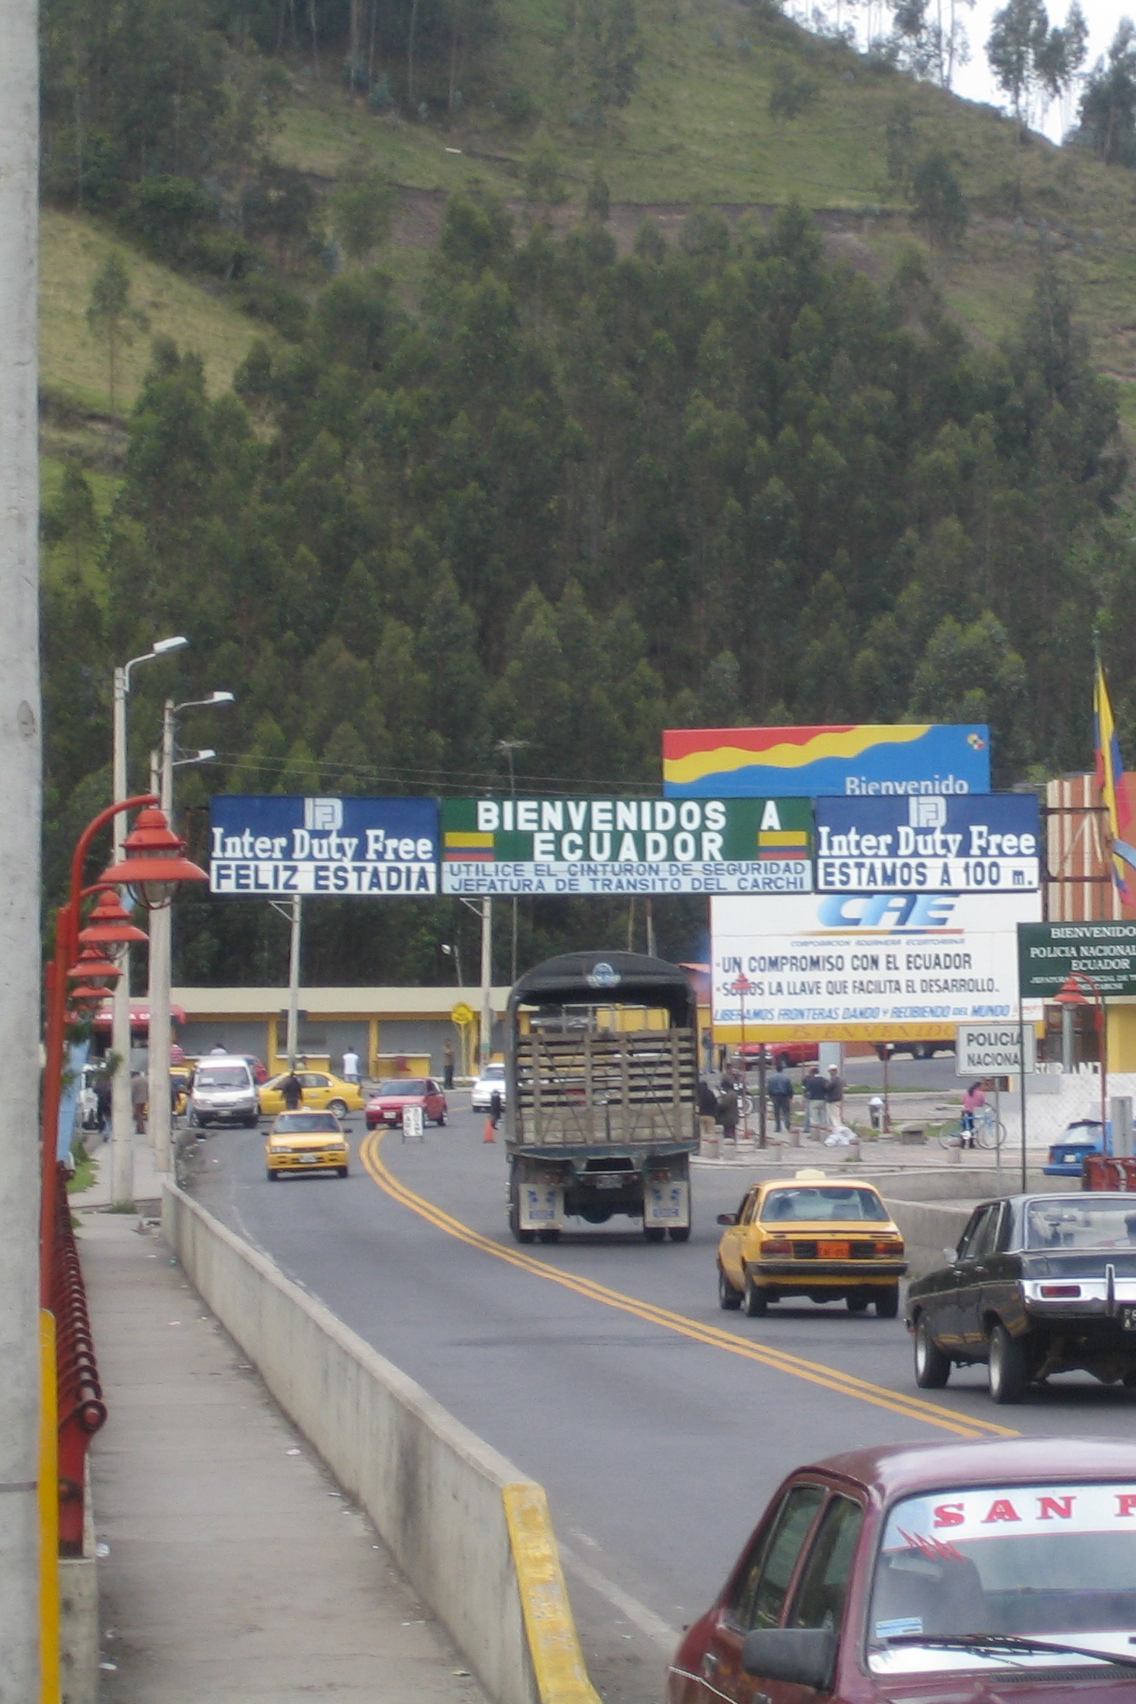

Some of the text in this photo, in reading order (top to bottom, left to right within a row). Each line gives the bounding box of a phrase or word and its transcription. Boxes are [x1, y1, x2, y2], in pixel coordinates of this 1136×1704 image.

[845, 775, 969, 795] Bienvenido
[477, 800, 782, 831] BIENVENIDOS A
[212, 828, 433, 862] Inter Duty Free
[533, 832, 724, 861] ECUADOR
[818, 825, 1036, 859] Inter Duty Free
[215, 865, 430, 891] FELIZ ESTADIA
[451, 862, 806, 877] UTILICE EL CINTURON DE SEGURIDAD
[823, 861, 1033, 887] ESTAMOS A 100 m.
[451, 877, 804, 892] JEFATURA DE TRANSITO DEL CARCHI
[817, 894, 960, 926] CAE
[1030, 946, 1077, 958] POLICIA
[722, 953, 972, 973] UN COMPROMISO CON EL ECUADOR
[1071, 959, 1130, 971] ECUADOR
[768, 981, 786, 996] LA
[788, 981, 821, 995] LLAVE
[826, 980, 849, 995] QUE
[852, 979, 902, 994] FACILITA
[906, 979, 917, 994] EL
[920, 978, 1000, 994] DESARROLLO.
[967, 1032, 1023, 1046] POLICIA
[967, 1052, 1022, 1066] NACIONA
[933, 1496, 1077, 1529] SAN
